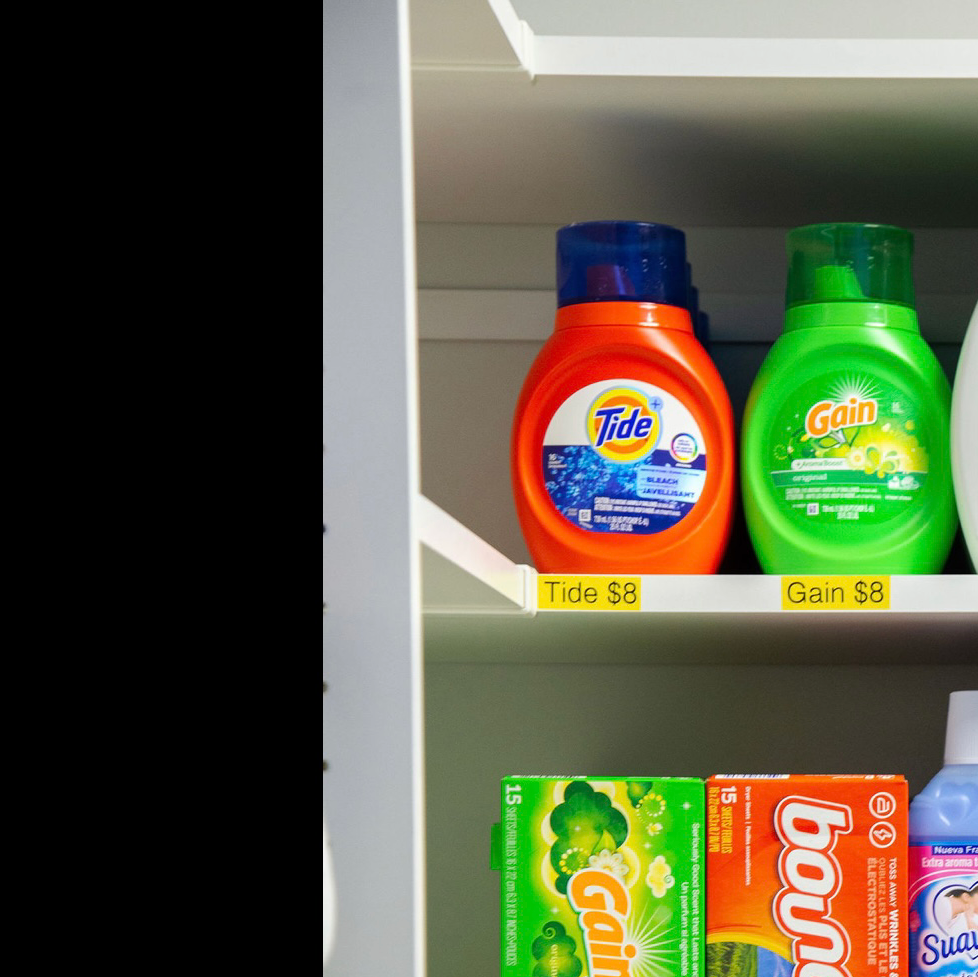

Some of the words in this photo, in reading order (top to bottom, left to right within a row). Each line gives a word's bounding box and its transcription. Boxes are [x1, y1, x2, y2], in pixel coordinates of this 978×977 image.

[595, 407, 652, 447] Tide
[807, 398, 876, 436] Gain
[646, 476, 679, 485] BLEACH
[792, 473, 827, 483] original
[544, 581, 598, 603] Tide
[607, 581, 637, 605] $8
[787, 581, 844, 604] Gain
[854, 580, 884, 604] $8
[506, 784, 521, 805] 15
[721, 786, 737, 804] 15
[690, 823, 700, 863] Seriously
[934, 846, 963, 854] Nueva
[889, 858, 897, 880] TOSS
[922, 858, 943, 867] Extra
[692, 864, 700, 888] Good
[878, 858, 886, 895] OUBLIEZ
[682, 882, 688, 894] Un
[680, 896, 688, 927] parfum
[692, 889, 700, 915] Scent
[867, 858, 878, 965] ÉLECTROSTATIQUE
[878, 897, 886, 913] LES
[692, 917, 700, 936] that
[879, 915, 887, 940] PLIS
[692, 938, 700, 961] Lasts
[879, 942, 887, 957] ET
[889, 909, 899, 970] WRINKLES
[879, 960, 887, 973] LE
